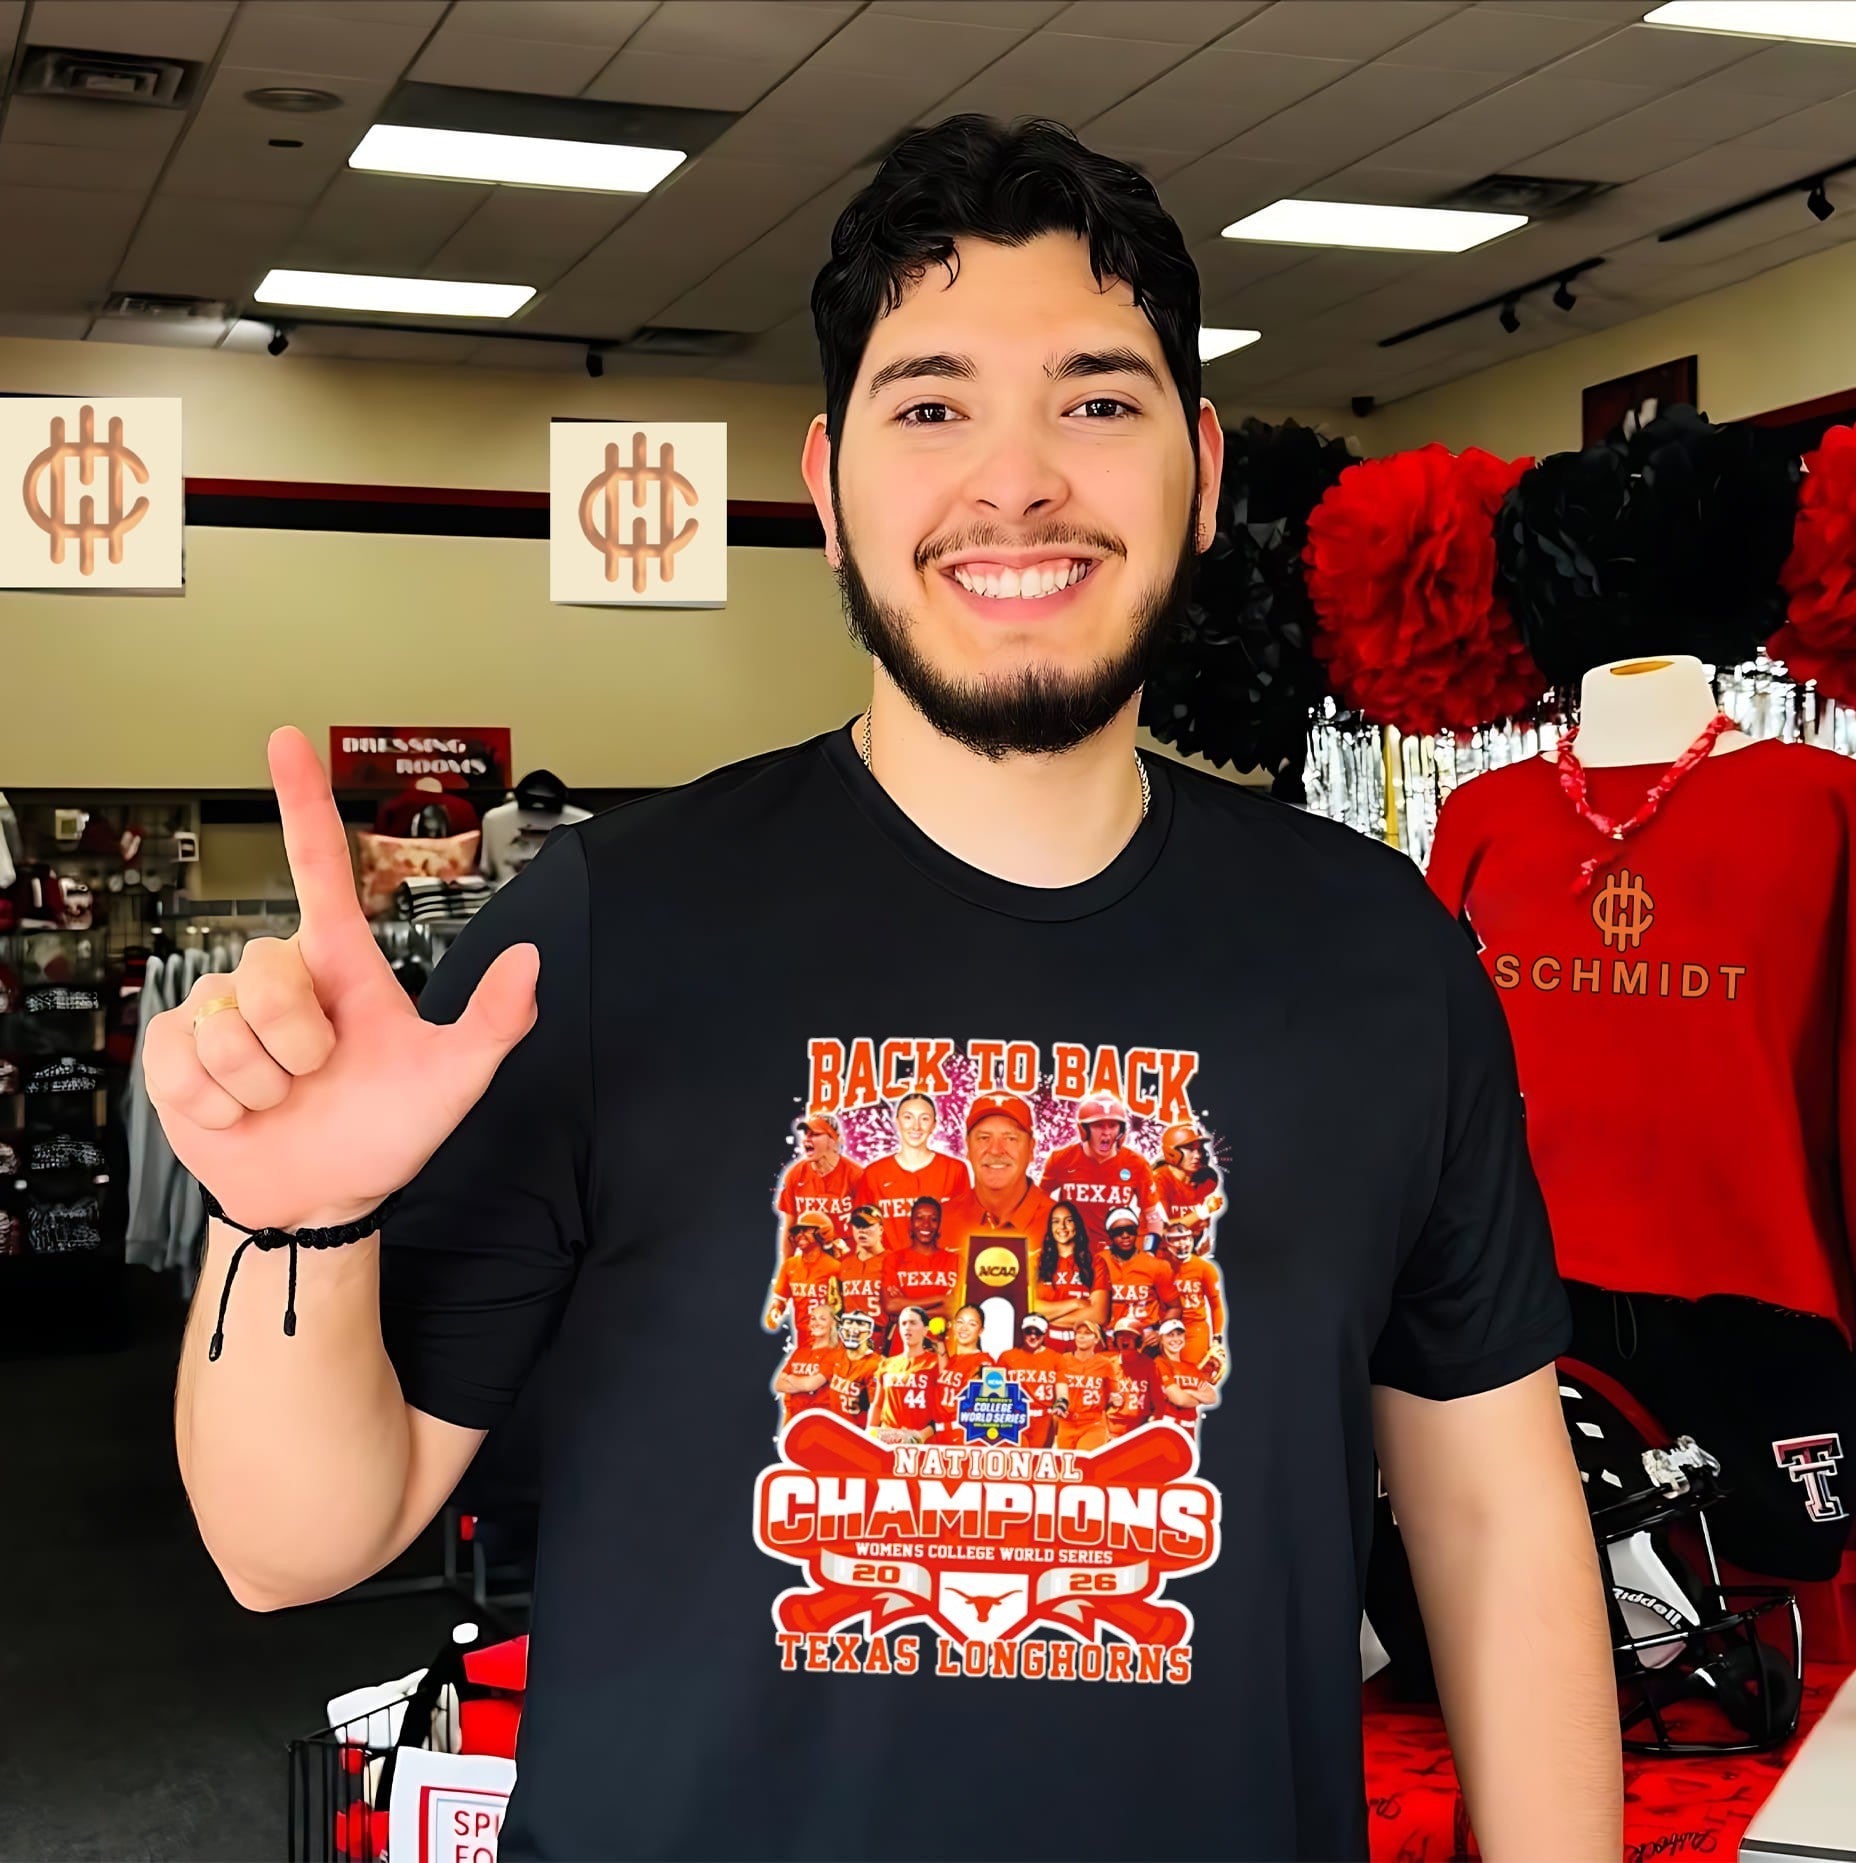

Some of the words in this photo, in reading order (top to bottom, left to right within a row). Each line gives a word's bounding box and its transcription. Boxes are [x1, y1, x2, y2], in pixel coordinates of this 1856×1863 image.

[342, 737, 467, 754] DRESSING
[396, 758, 487, 775] ROOMS
[1494, 954, 1746, 1000] SCHMIDT
[808, 1038, 954, 1117] BACK
[967, 1039, 1040, 1092] TO
[1053, 1042, 1199, 1124] BACK
[1063, 1183, 1132, 1203] TEXAS
[795, 1196, 852, 1213] TEXAS
[897, 1271, 958, 1288] TEXAS
[979, 1265, 1016, 1277] NCAA
[1112, 1284, 1149, 1300] XAS
[1007, 1369, 1056, 1384] TEXAS
[904, 1389, 927, 1409] 44
[1034, 1384, 1054, 1401] 43
[974, 1403, 1013, 1413] COLLEGE
[961, 1412, 993, 1422] WORLD
[994, 1413, 1026, 1424] SERIES
[894, 1447, 1083, 1482] NATIONAL
[768, 1475, 1207, 1559] CHAMPIONS
[856, 1542, 924, 1558] WOMENS
[928, 1544, 995, 1561] COLLEGE
[1000, 1547, 1055, 1563] WORLD
[1059, 1549, 1113, 1565] SERIES
[852, 1564, 900, 1583] 20
[1069, 1573, 1117, 1592] 26
[778, 1633, 919, 1676] TEXAS
[936, 1638, 1192, 1684] LONGHORNS
